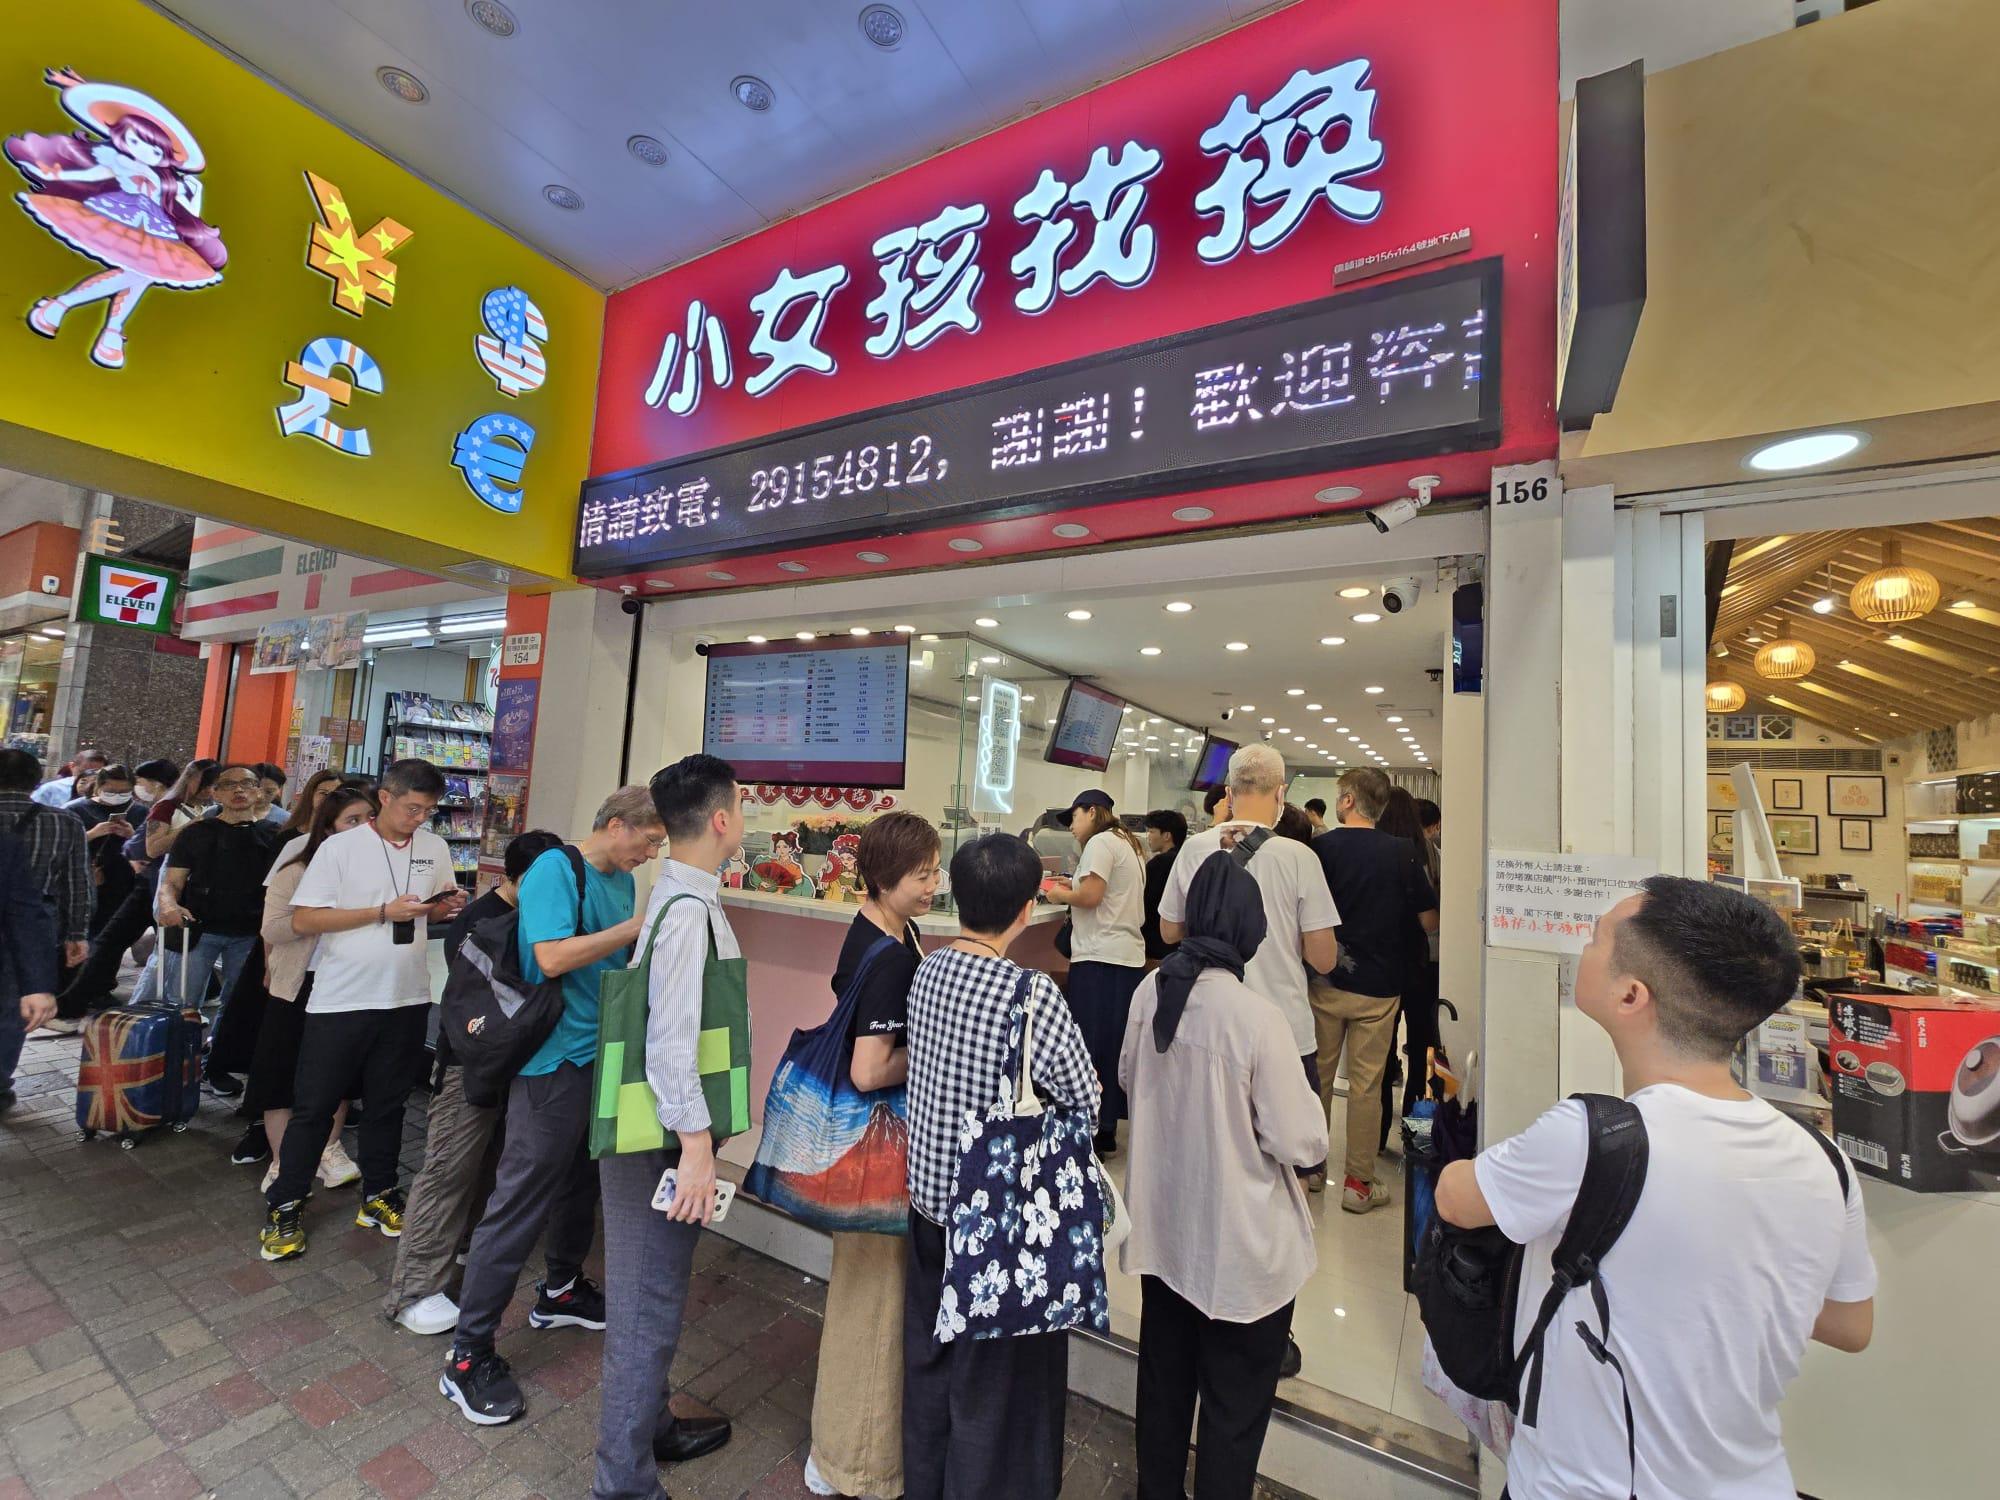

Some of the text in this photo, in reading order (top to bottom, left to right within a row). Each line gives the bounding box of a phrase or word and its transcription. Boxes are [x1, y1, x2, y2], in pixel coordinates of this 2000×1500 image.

[645, 57, 1386, 417] 小女孩找換
[1496, 477, 1548, 505] 156
[513, 652, 529, 664] 154
